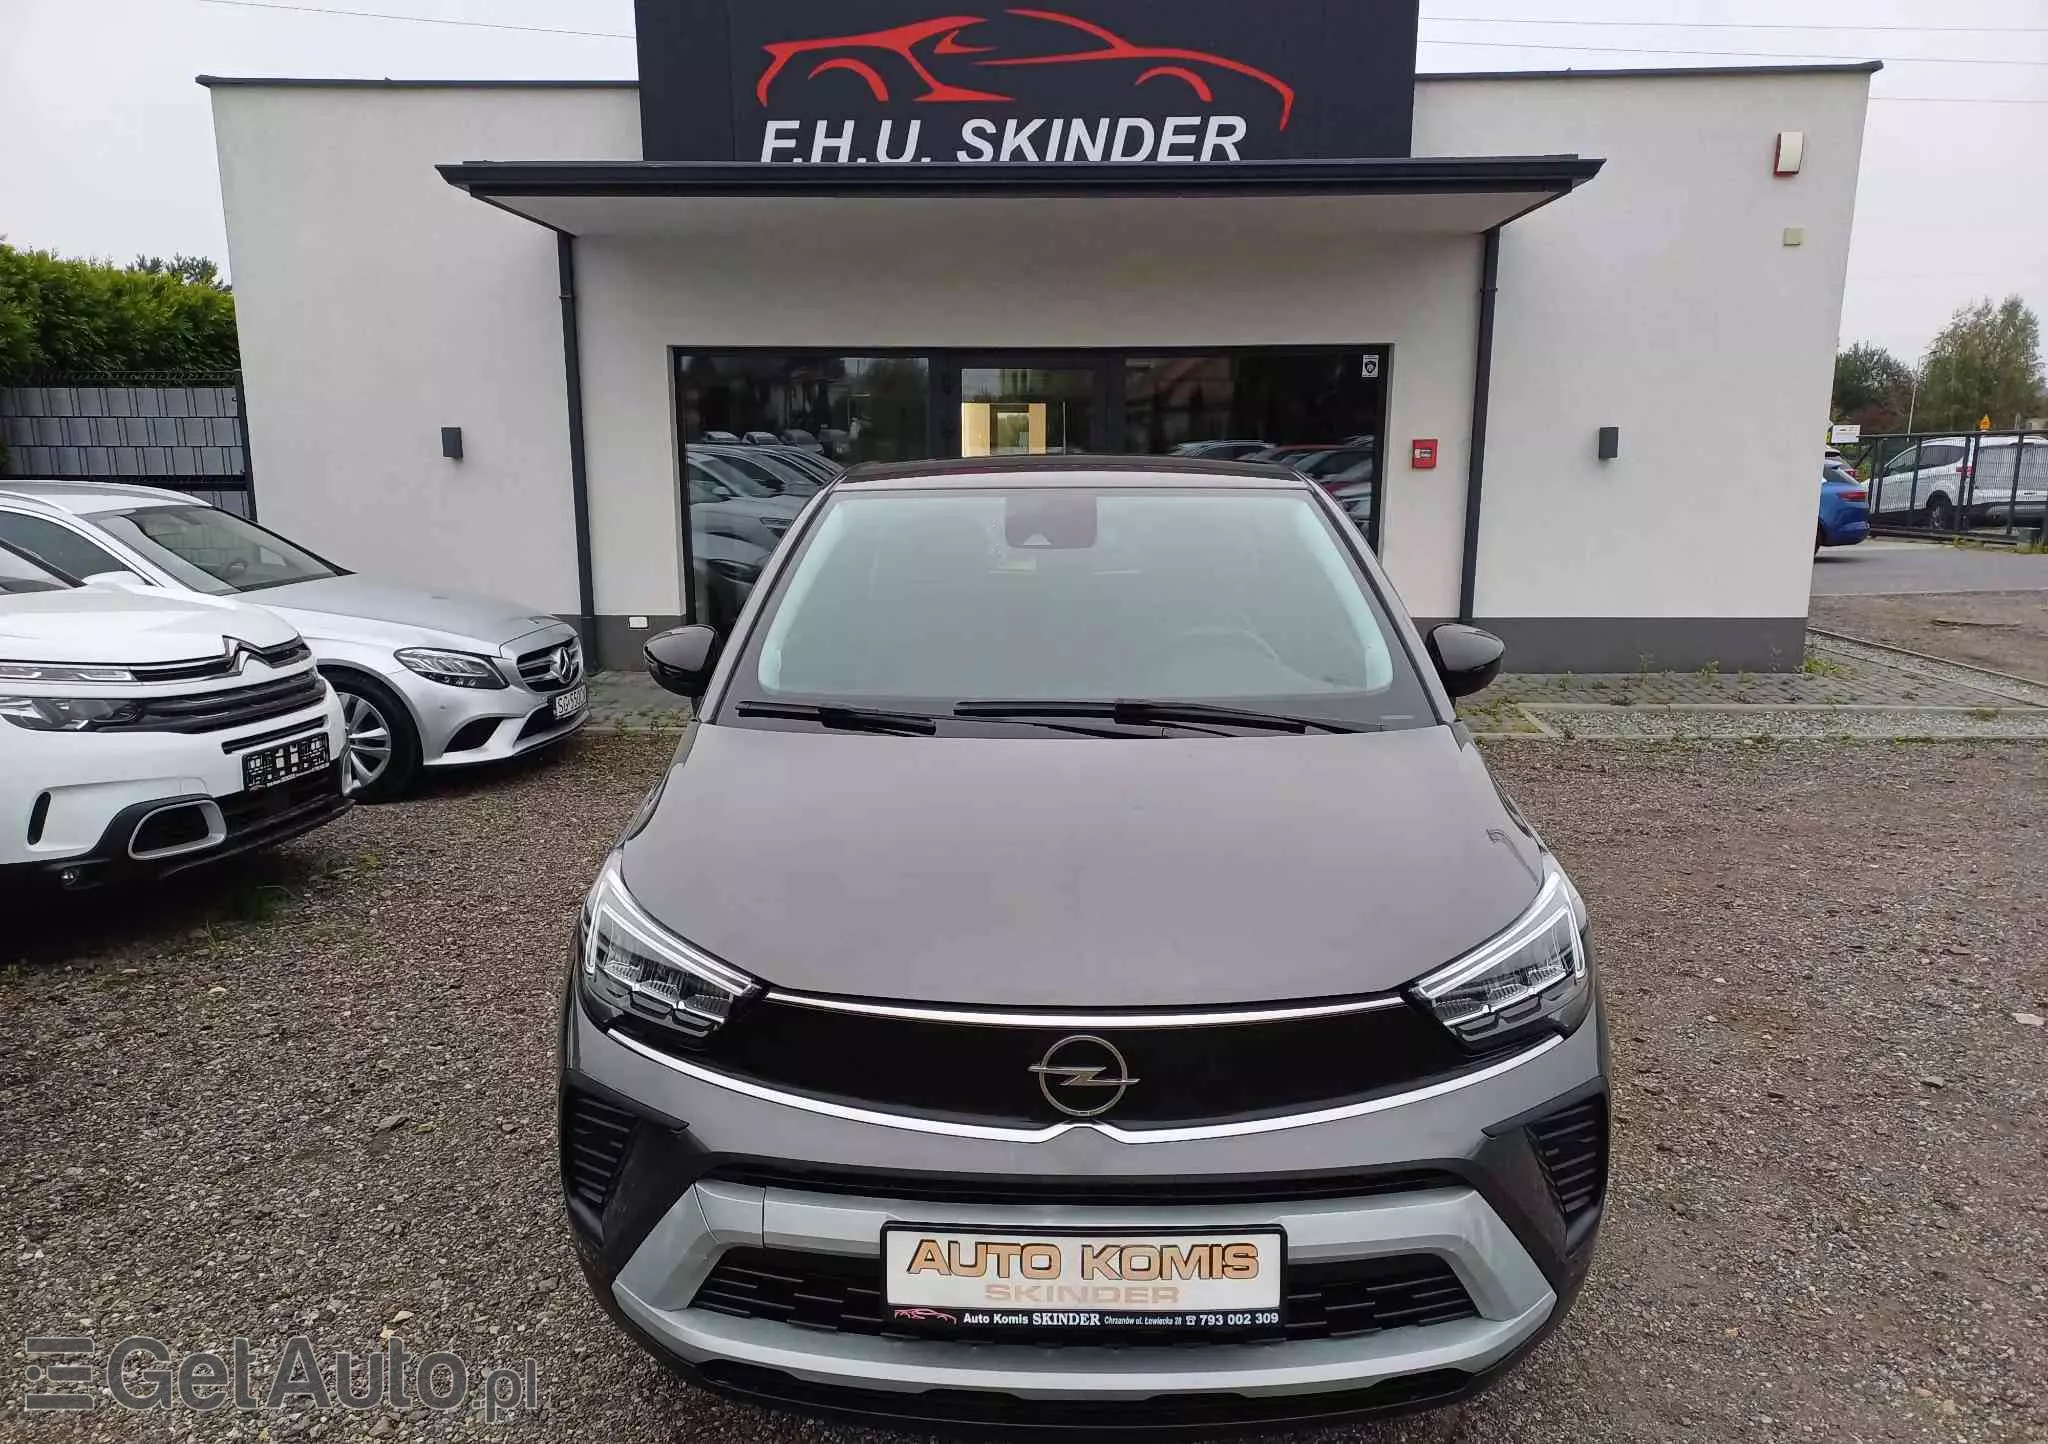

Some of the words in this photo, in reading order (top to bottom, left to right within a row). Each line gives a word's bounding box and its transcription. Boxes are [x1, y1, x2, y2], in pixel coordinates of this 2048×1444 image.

[761, 117, 931, 163] F.H.U.
[956, 115, 1247, 162] SKINDER
[907, 1238, 1062, 1280] AUTO
[1081, 1242, 1260, 1282] KOMIS
[985, 1284, 1182, 1305] SKINDER
[963, 1313, 990, 1324] Auto
[993, 1313, 1029, 1324] Komis
[1032, 1312, 1101, 1326] SKINDER
[1200, 1314, 1224, 1326] 793
[1228, 1313, 1252, 1325] 002
[1255, 1312, 1279, 1325] 309
